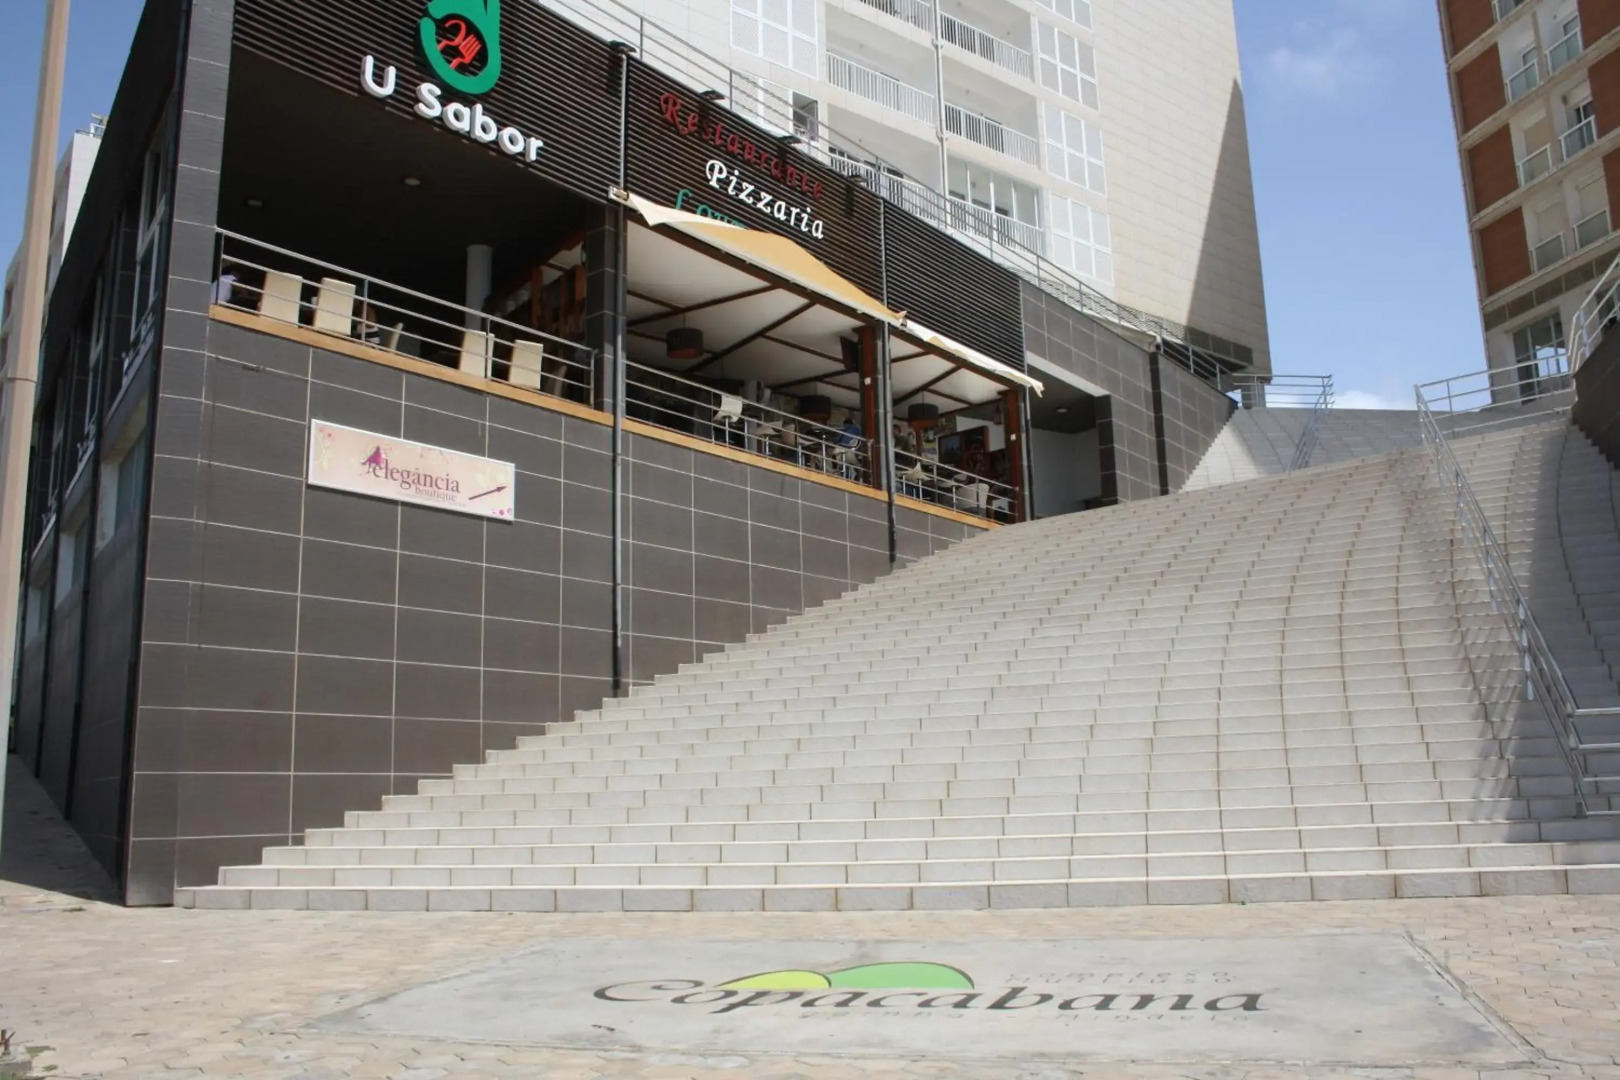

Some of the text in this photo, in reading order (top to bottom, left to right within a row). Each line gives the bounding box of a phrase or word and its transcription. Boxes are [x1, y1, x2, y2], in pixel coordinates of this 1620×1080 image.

[360, 54, 544, 162] U Sabor
[659, 92, 824, 200] Restaurante
[705, 159, 825, 239] Pizzaria
[414, 485, 458, 504] boutique
[593, 979, 1272, 1014] Copacabana
